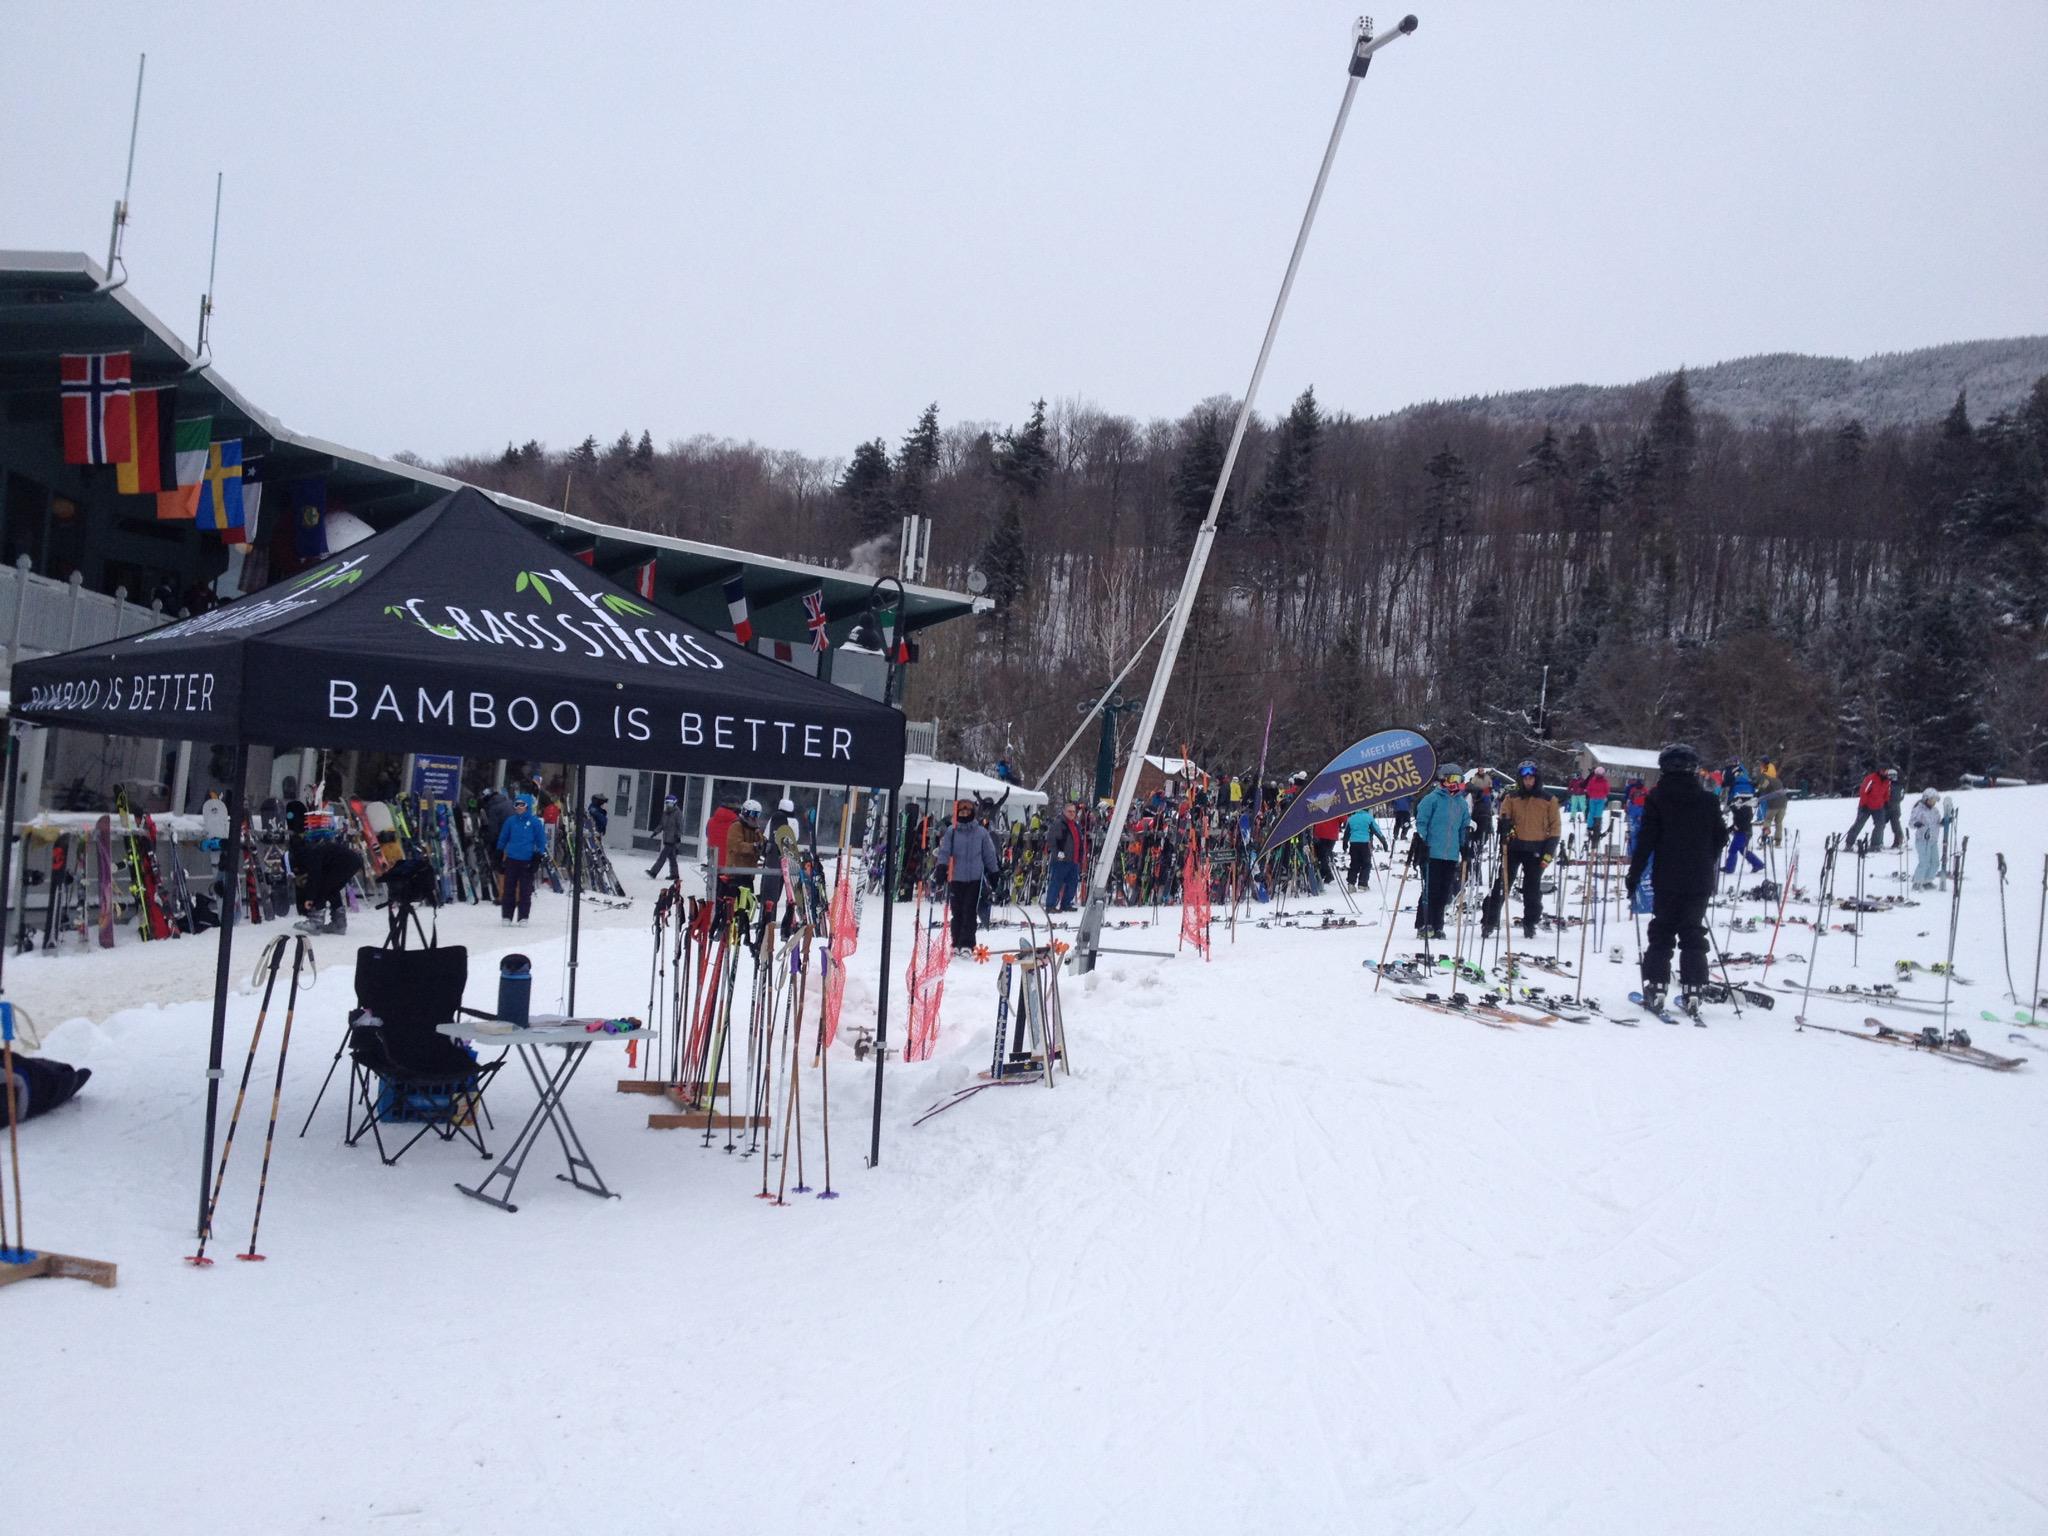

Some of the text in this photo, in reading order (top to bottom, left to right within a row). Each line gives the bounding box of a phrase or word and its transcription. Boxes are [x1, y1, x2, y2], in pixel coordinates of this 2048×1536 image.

[405, 598, 567, 652] GRASS
[551, 569, 724, 670] STICKS
[102, 676, 123, 711] IS
[128, 673, 215, 712] BETTER
[328, 679, 853, 761] BAMBOO IS BETTER
[1360, 737, 1413, 759] MEET HERE
[1340, 753, 1416, 790] PRIVATE
[1345, 770, 1422, 805] LESSONS
